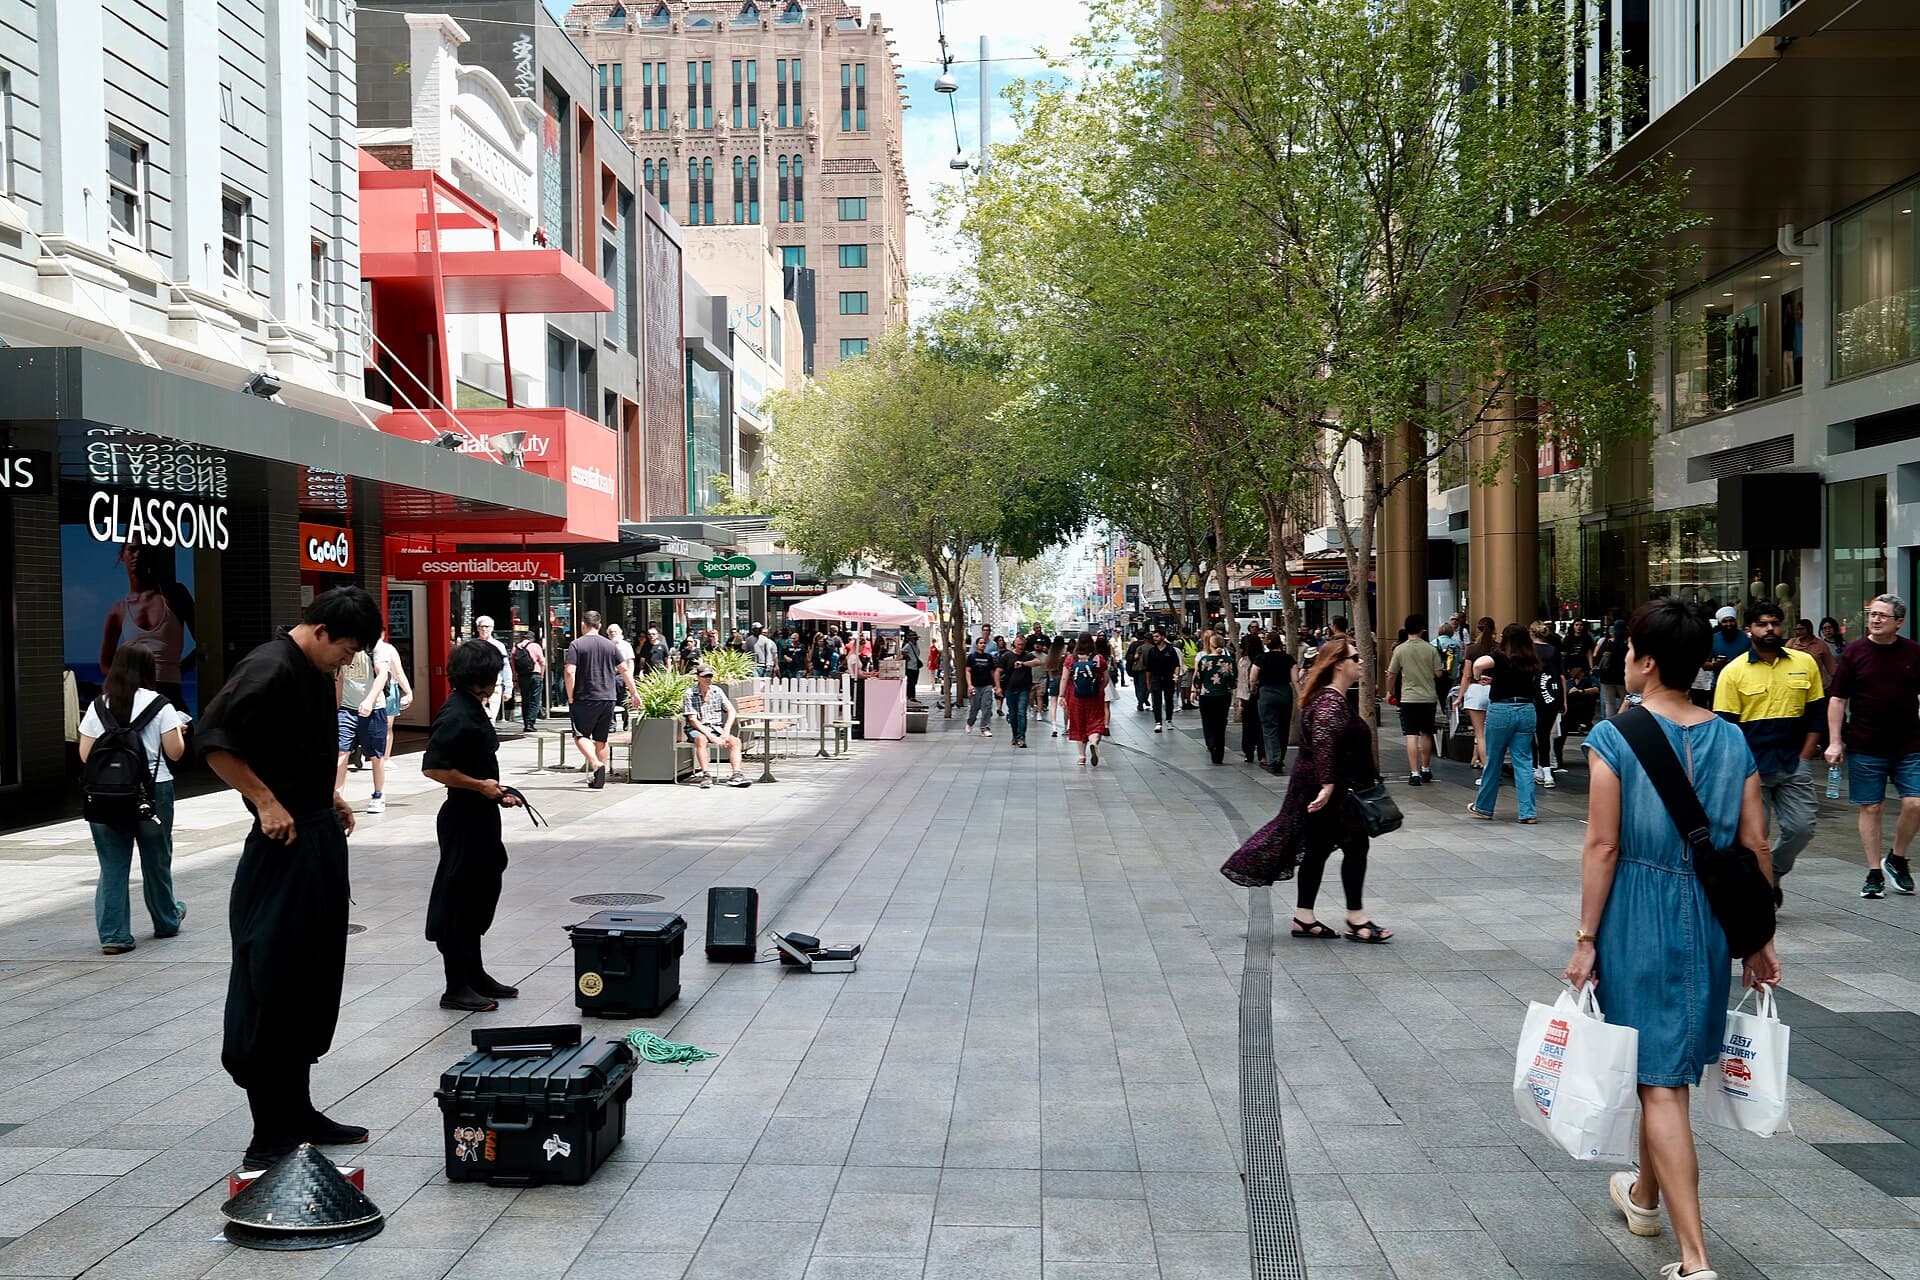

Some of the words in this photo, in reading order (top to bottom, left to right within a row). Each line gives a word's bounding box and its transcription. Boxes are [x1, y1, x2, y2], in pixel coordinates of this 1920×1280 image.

[89, 491, 229, 551] GLASSONS
[422, 558, 540, 576] essentialbeauty
[703, 562, 751, 572] Specsavers
[607, 582, 687, 594] TAROCASH
[1731, 1034, 1752, 1047] FAST
[1543, 1042, 1566, 1056] BEAT
[1720, 1044, 1757, 1060] DELIVERY
